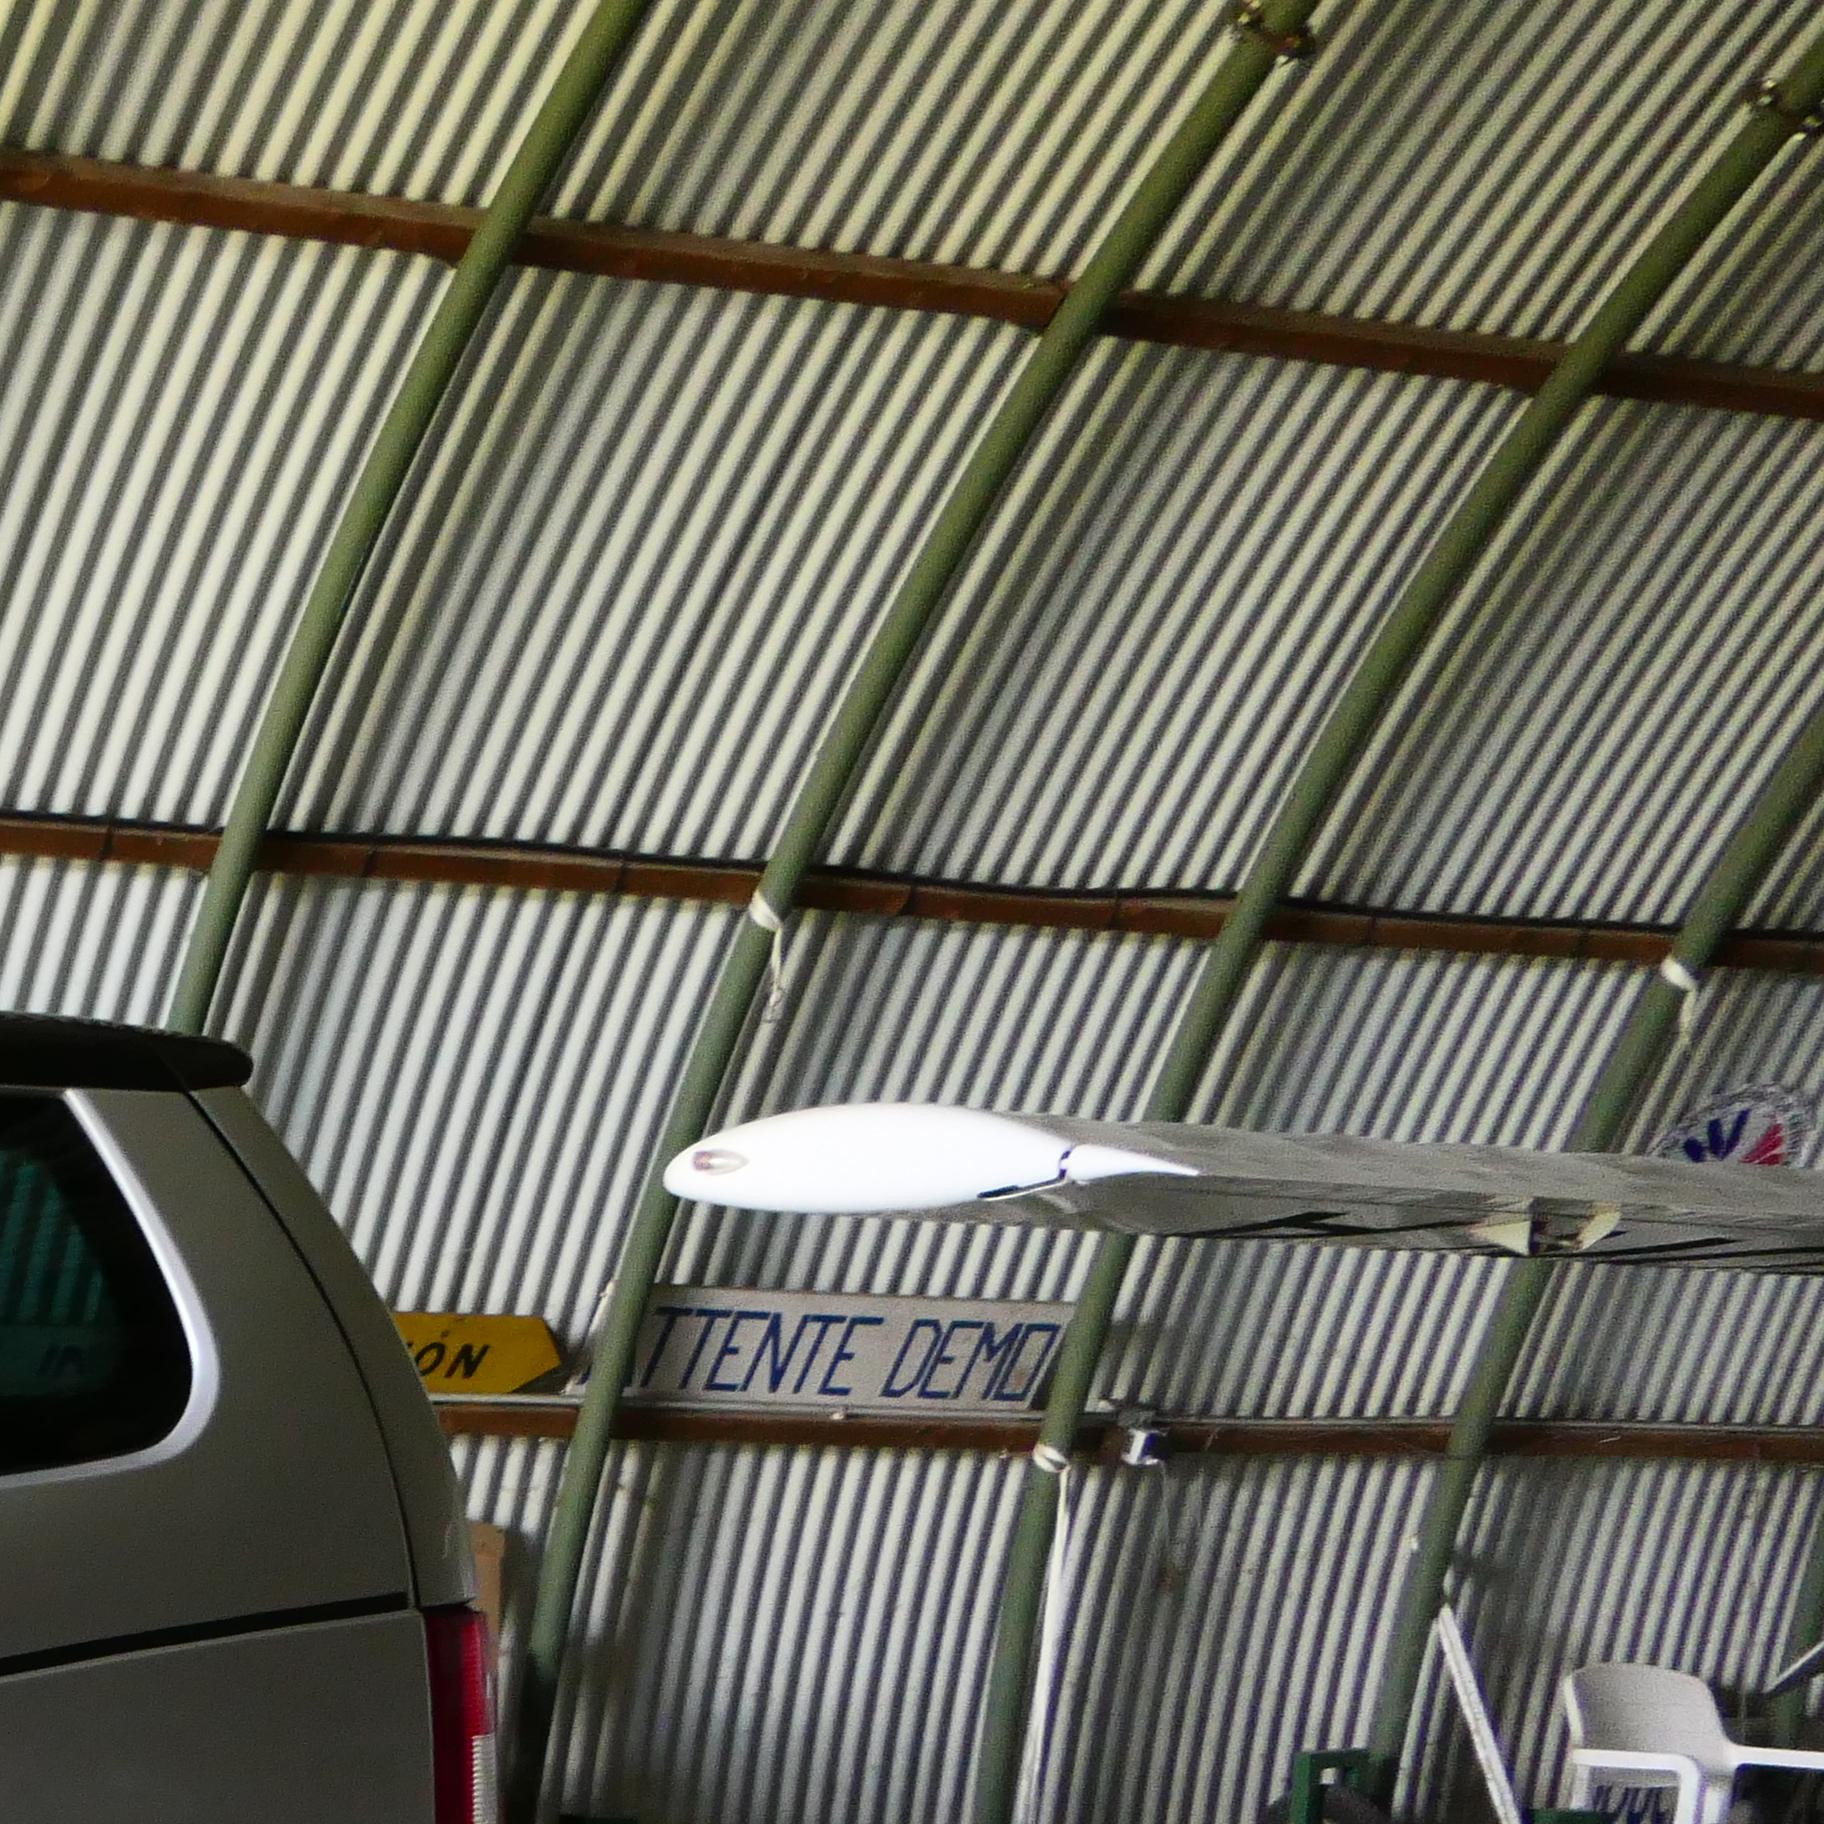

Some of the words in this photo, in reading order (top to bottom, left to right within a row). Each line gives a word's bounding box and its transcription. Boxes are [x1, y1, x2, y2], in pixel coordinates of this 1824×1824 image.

[406, 1339, 491, 1379] ON
[577, 1305, 884, 1396] TTENTE
[879, 1317, 1061, 1401] DEMO
